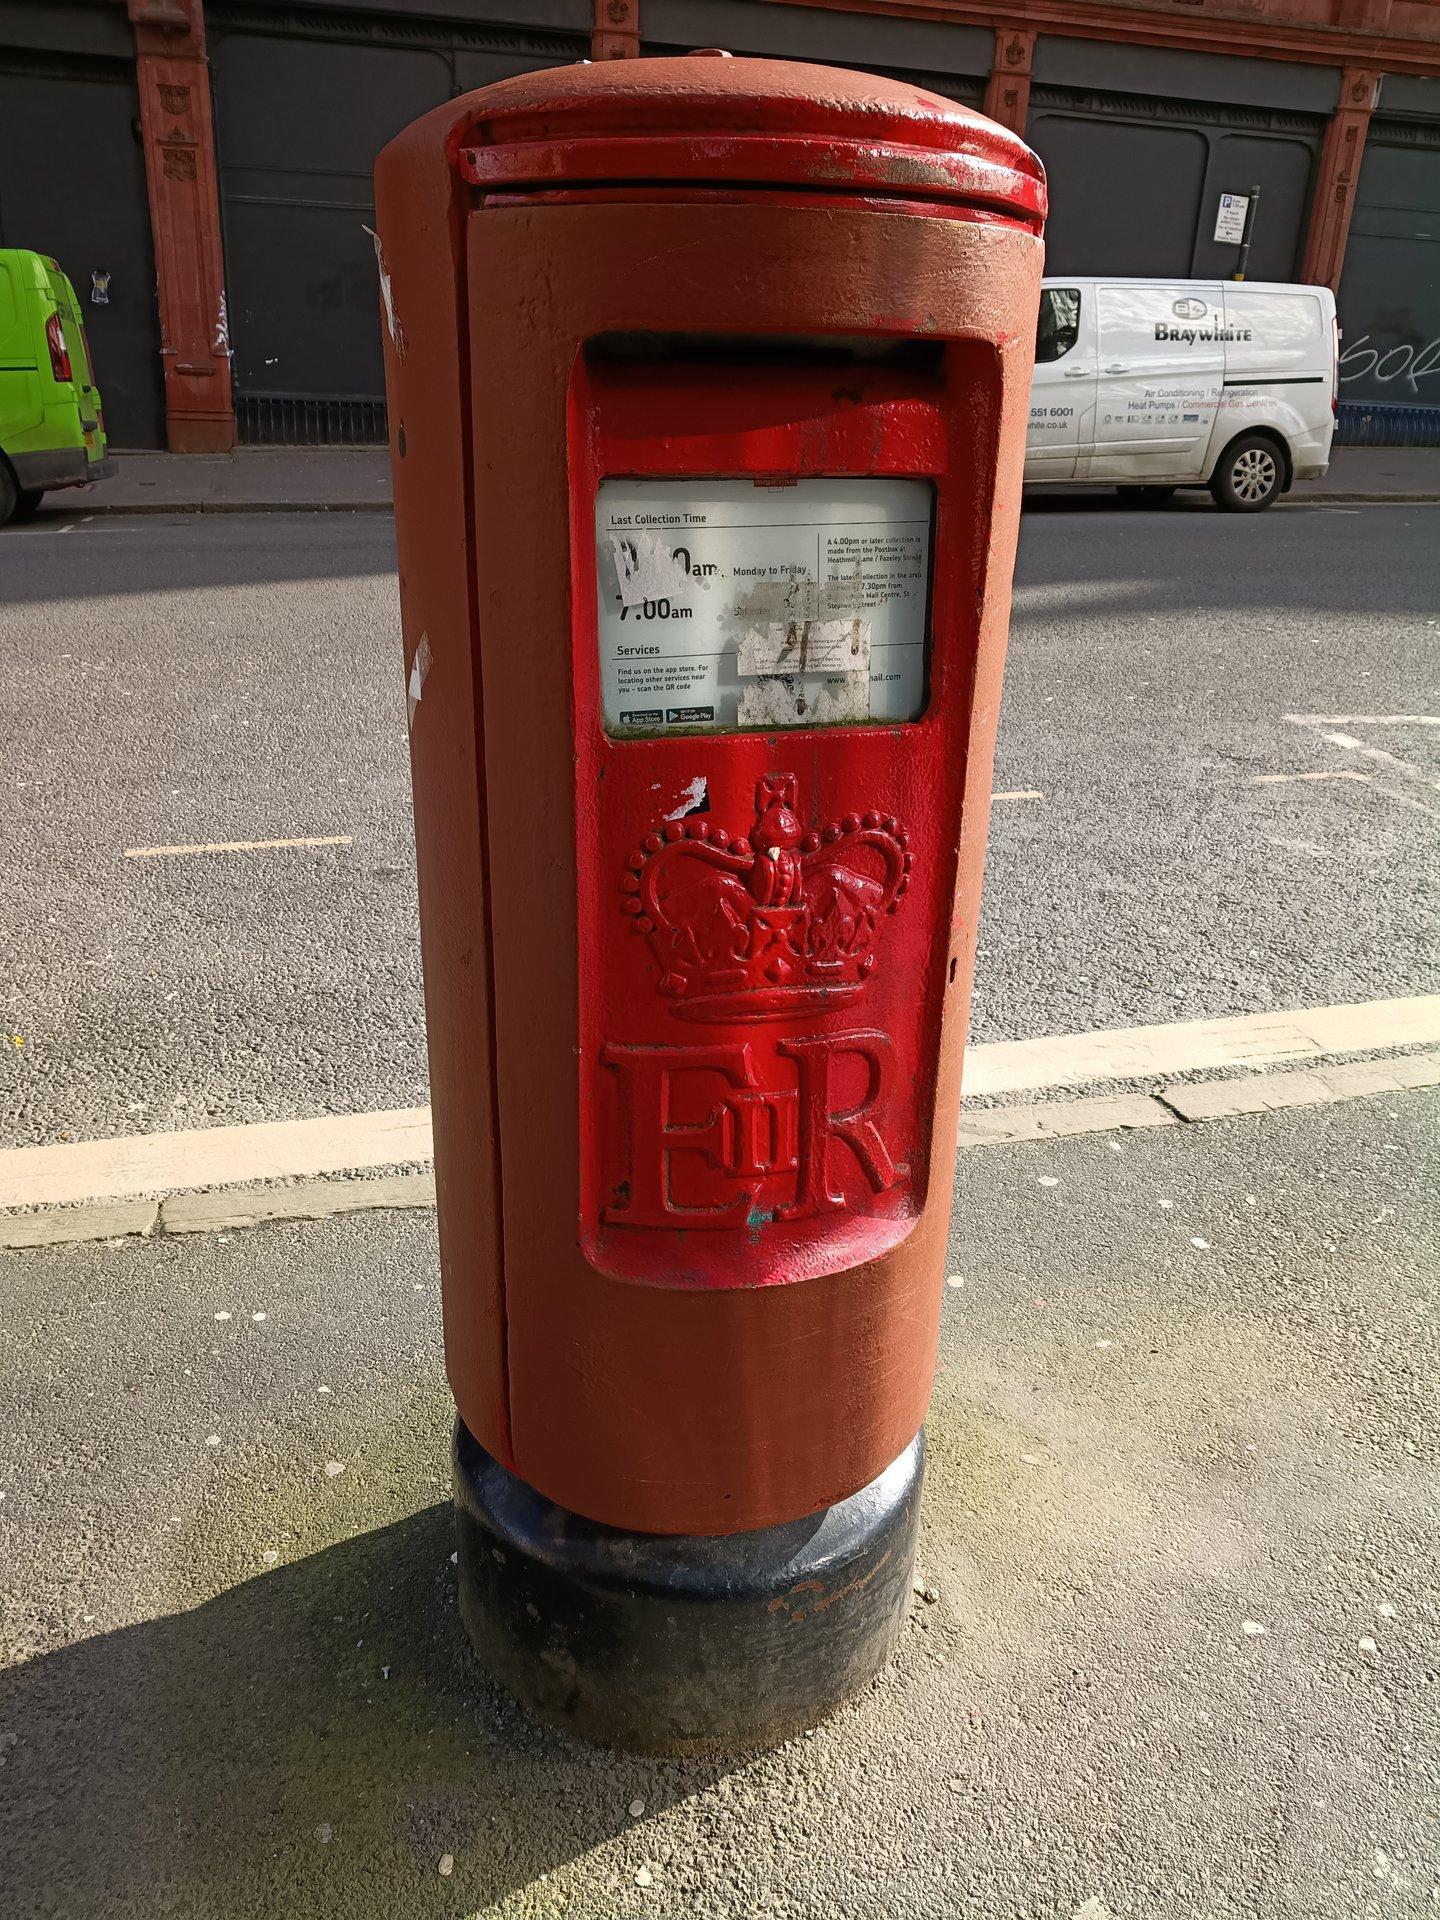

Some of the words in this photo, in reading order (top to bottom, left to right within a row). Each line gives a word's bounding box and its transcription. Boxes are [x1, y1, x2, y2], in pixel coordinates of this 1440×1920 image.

[1158, 389, 1205, 398] Conditioning
[1128, 401, 1147, 410] Heat
[1148, 401, 1175, 410] Pumps
[1031, 408, 1047, 416] 551
[1050, 408, 1073, 416] 6001
[611, 515, 632, 525] Last
[635, 513, 681, 524] Collection
[683, 513, 707, 523] Time
[733, 567, 766, 577] Monday
[780, 565, 807, 575] Friday
[861, 582, 887, 591] 7.30pm
[866, 590, 879, 598] Mail
[617, 645, 660, 656] Services
